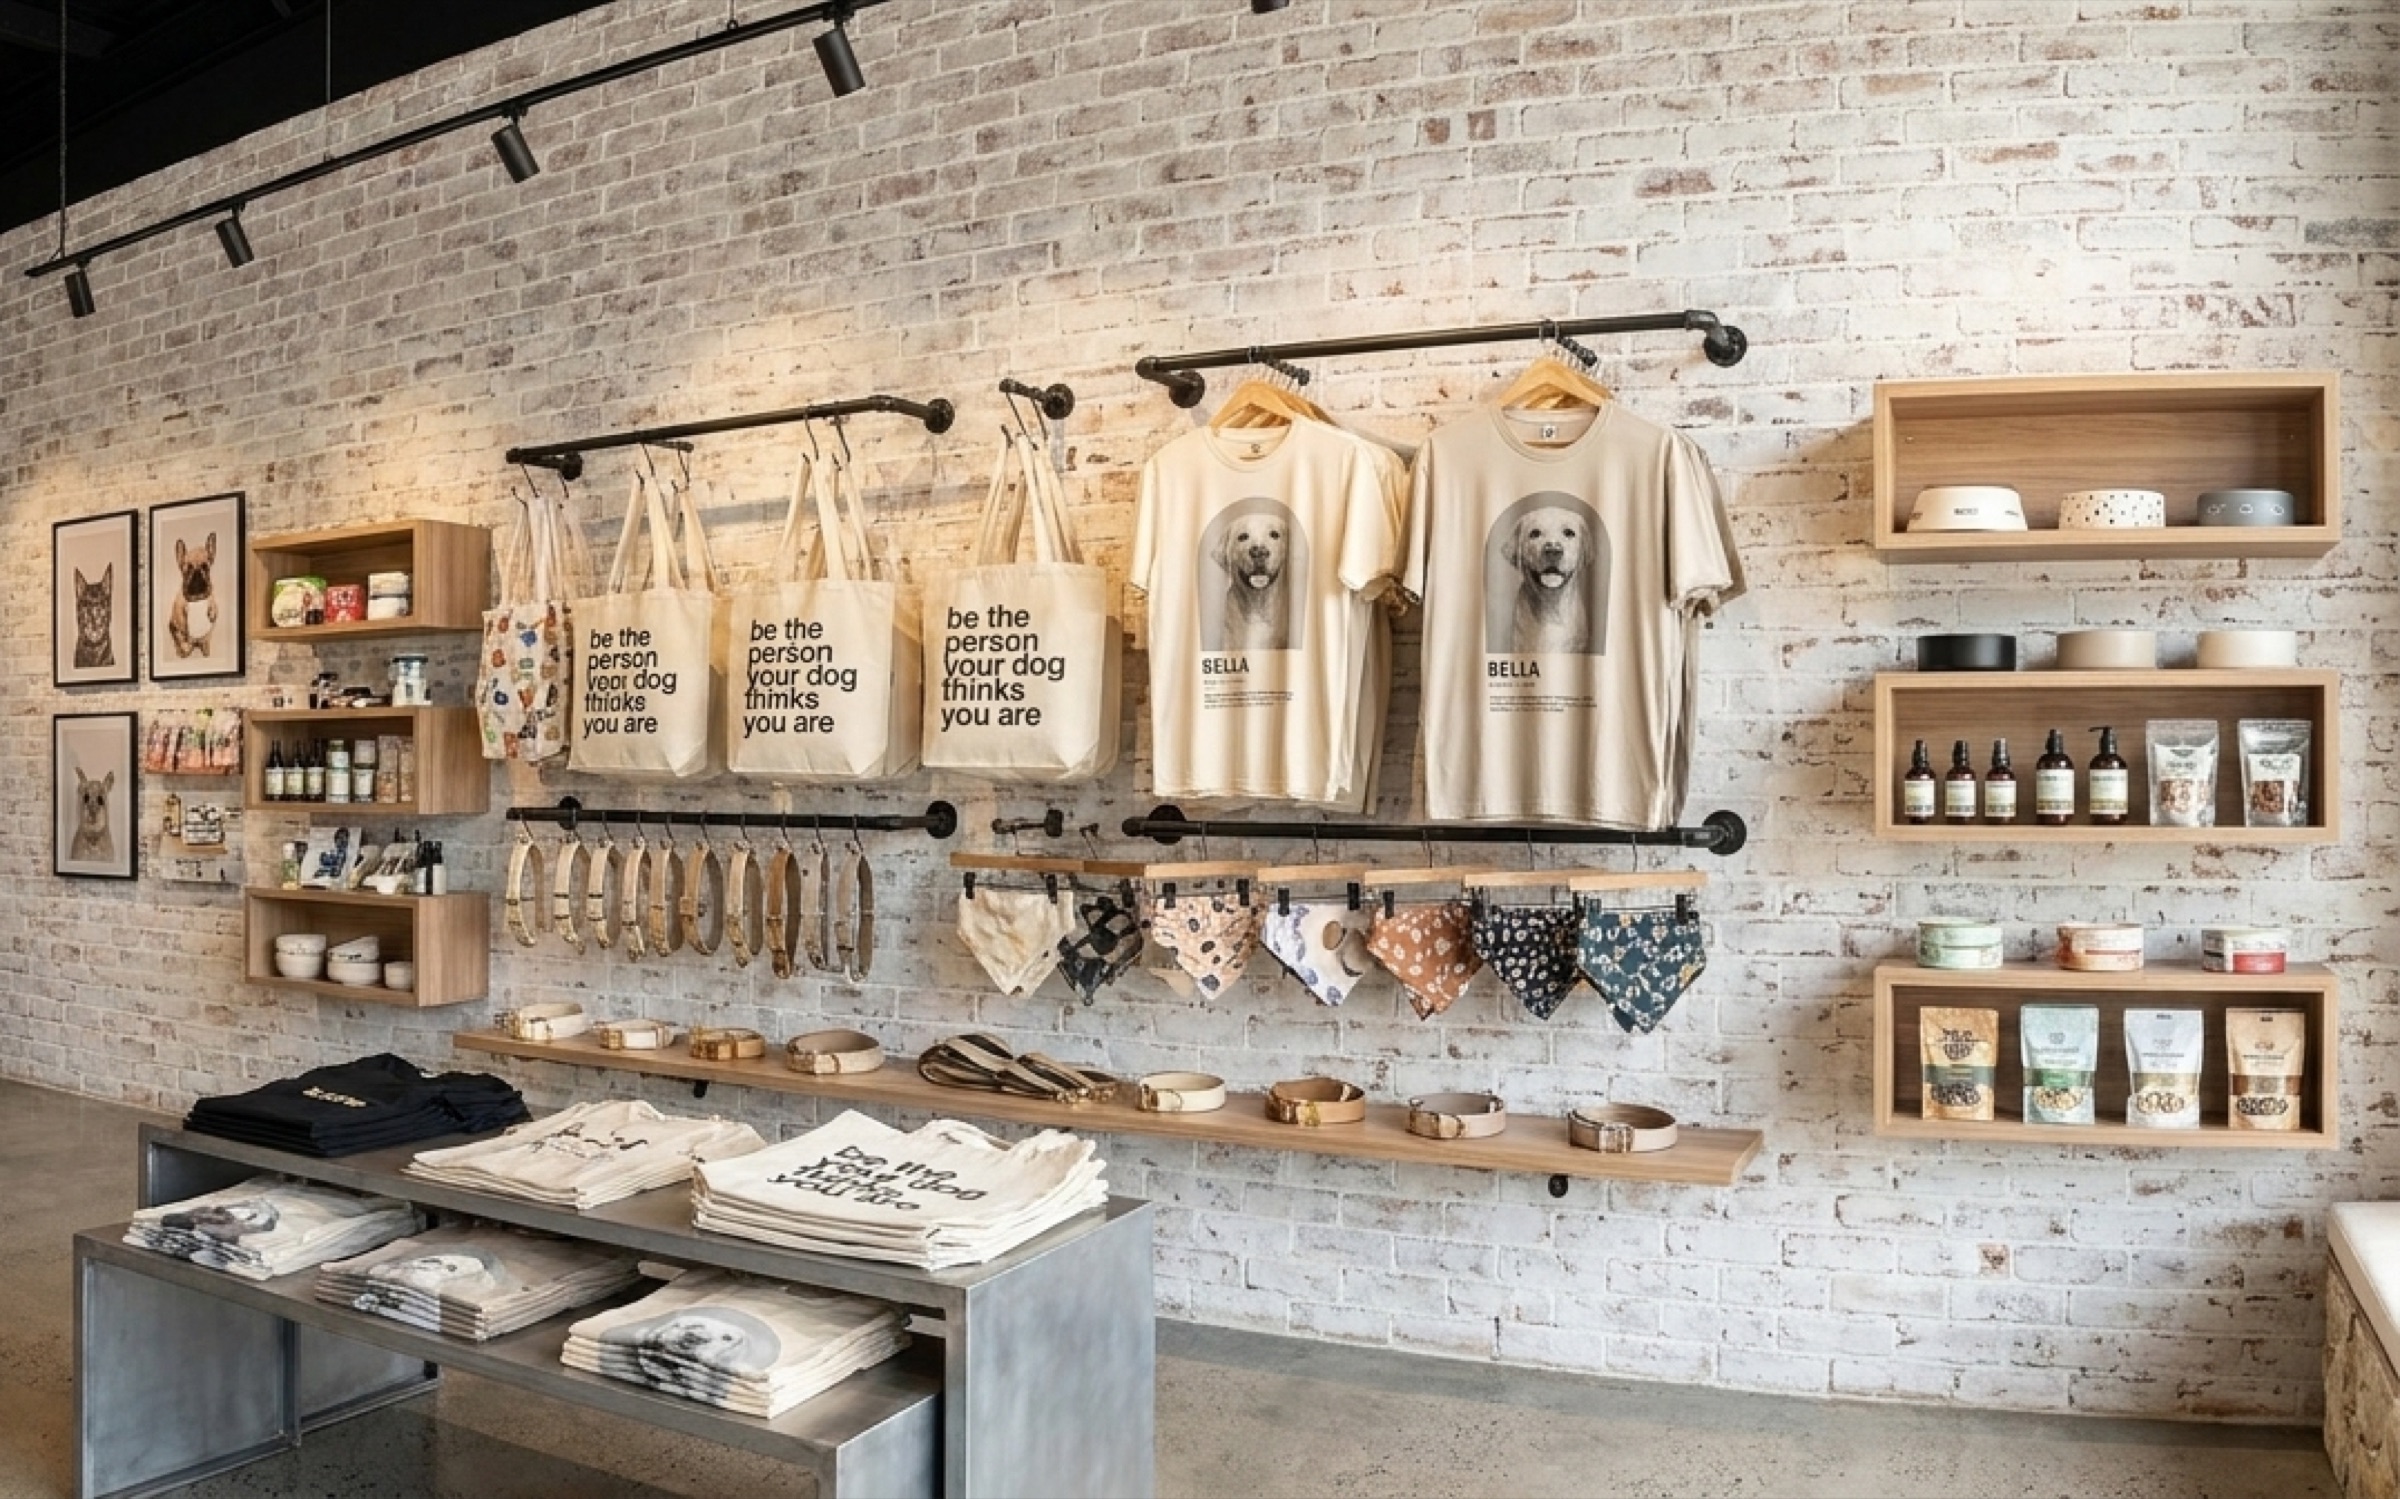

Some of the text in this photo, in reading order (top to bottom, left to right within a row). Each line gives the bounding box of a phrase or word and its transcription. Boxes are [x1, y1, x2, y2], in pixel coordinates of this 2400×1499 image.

[947, 604, 1031, 629] be the
[590, 627, 651, 649] be the
[751, 617, 823, 641] be the
[748, 644, 833, 669] person
[945, 633, 1038, 657] person
[587, 650, 658, 673] person
[944, 653, 1065, 681] your dog
[1487, 660, 1540, 678] BELLA
[633, 669, 678, 695] dog
[747, 664, 857, 692] your dog
[941, 678, 1025, 701] thinks
[582, 716, 658, 740] you are
[743, 715, 835, 739] you are
[941, 706, 1042, 732] you are
